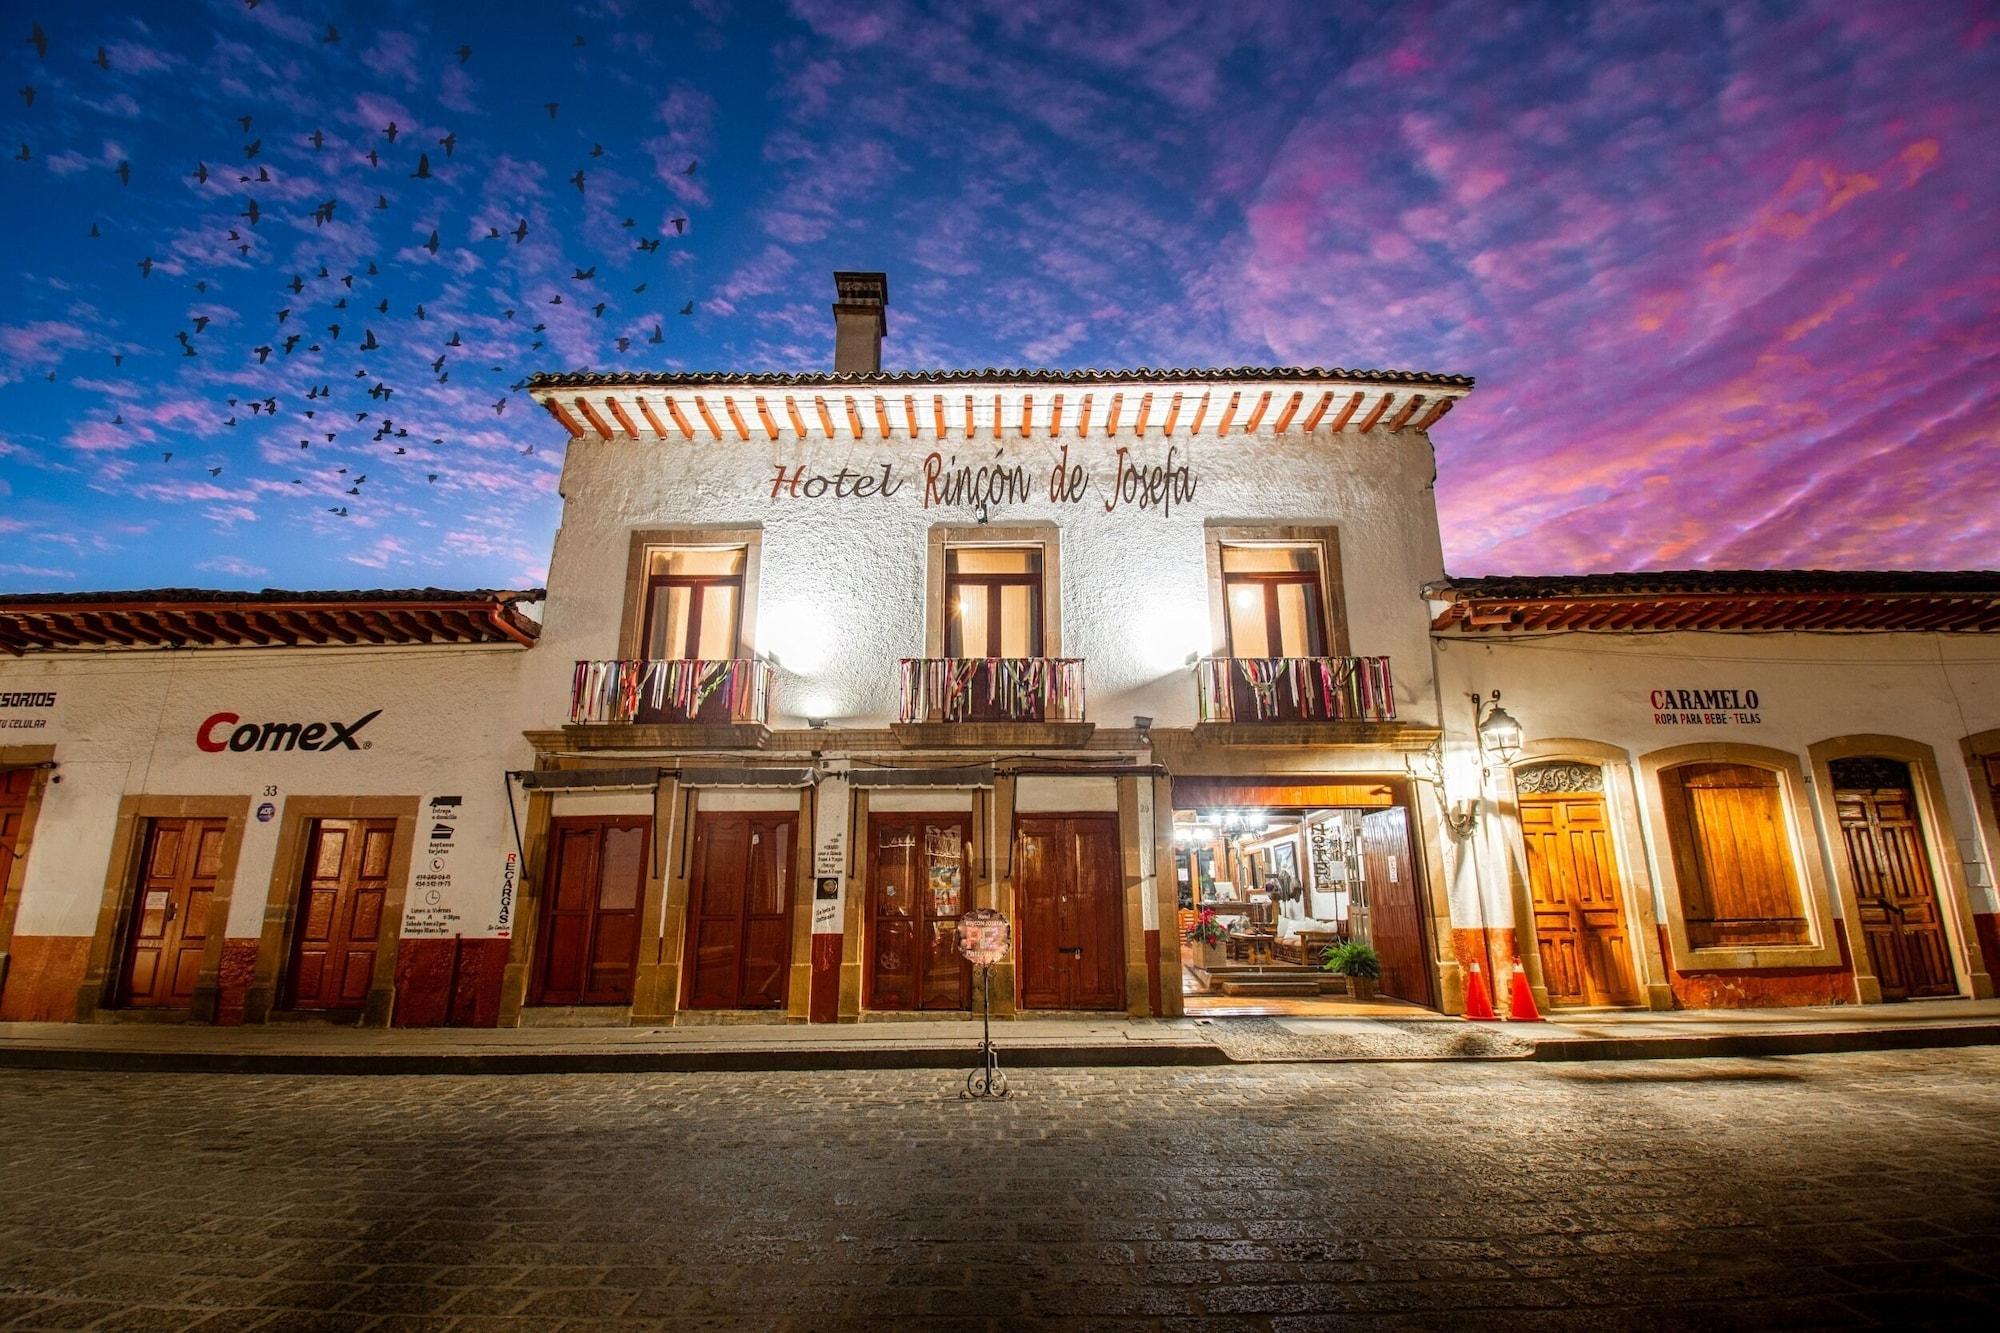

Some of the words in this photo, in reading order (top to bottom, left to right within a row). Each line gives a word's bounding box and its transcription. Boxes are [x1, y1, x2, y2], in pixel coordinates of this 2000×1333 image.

[768, 464, 904, 498] Hotel
[923, 448, 1031, 509] Rincón
[1050, 444, 1089, 504] de
[1105, 446, 1197, 519] Josefa
[0, 692, 57, 707] SORIOS
[1650, 689, 1759, 709] CARAMELO
[9, 719, 47, 729] CELULAR
[1654, 713, 1678, 725] ROPA
[1680, 713, 1702, 725] PARA
[1733, 713, 1761, 724] TELAS
[263, 785, 278, 797] 33
[499, 853, 516, 924] RECARGAS
